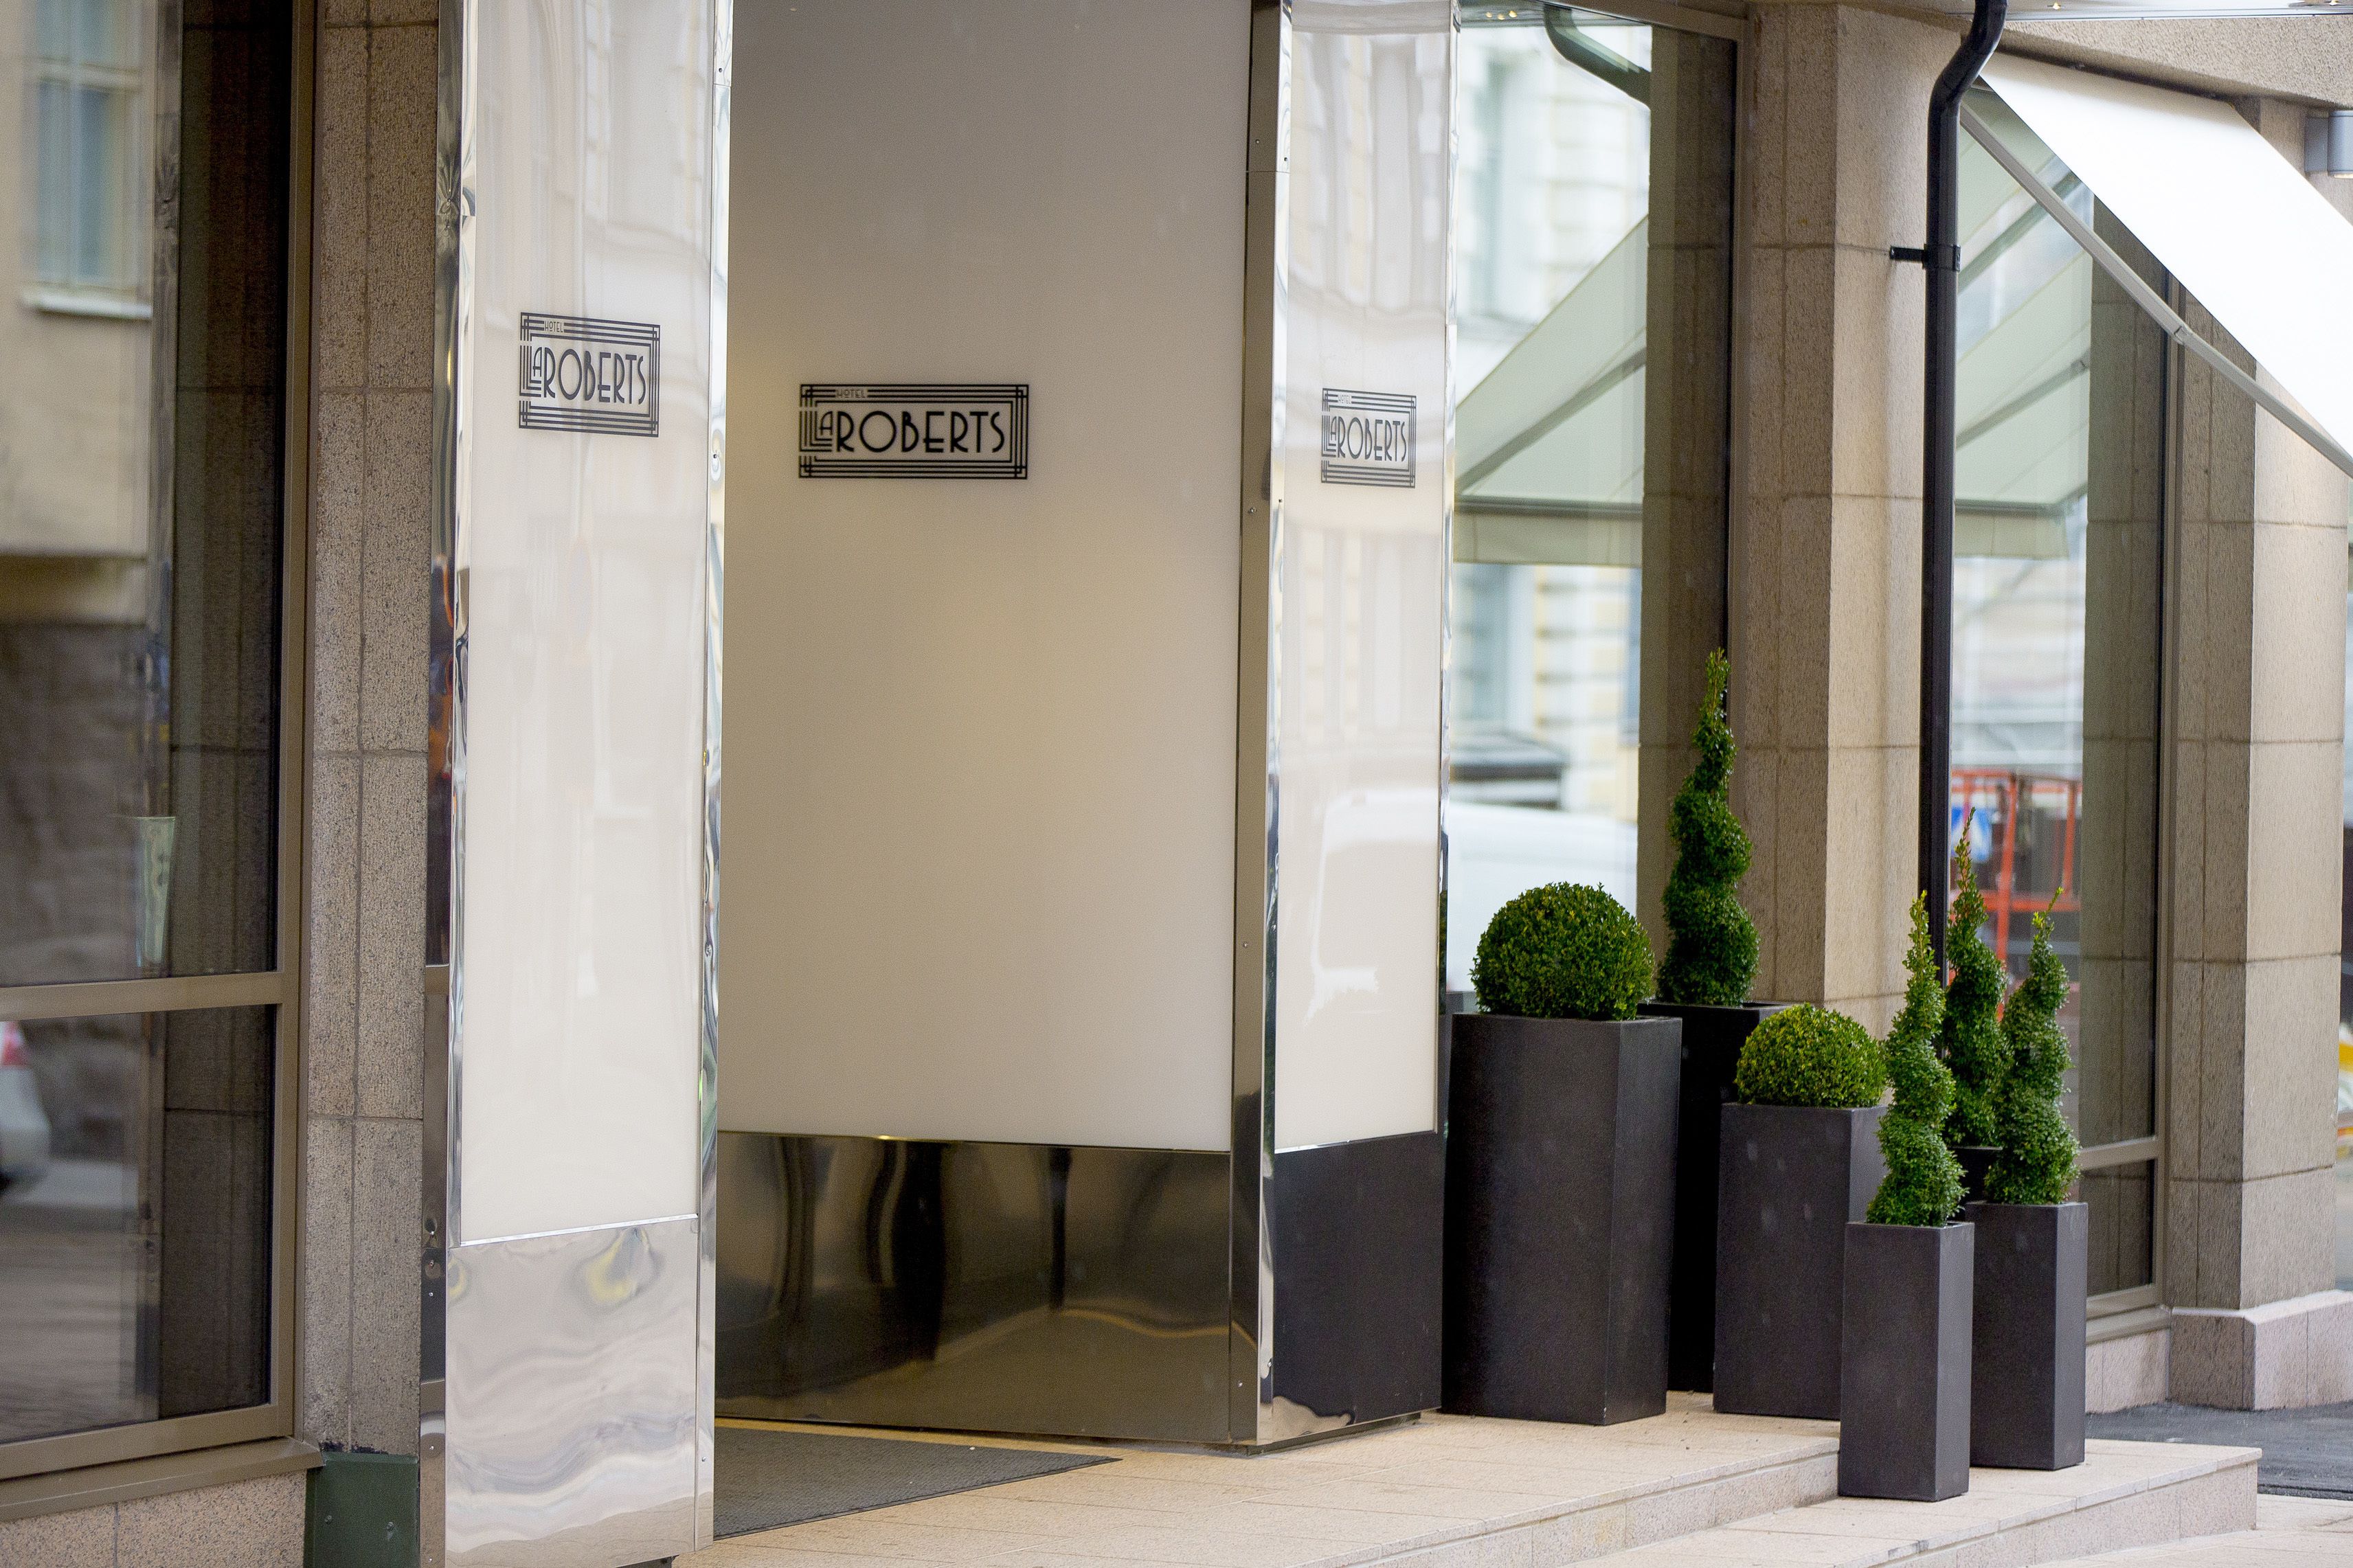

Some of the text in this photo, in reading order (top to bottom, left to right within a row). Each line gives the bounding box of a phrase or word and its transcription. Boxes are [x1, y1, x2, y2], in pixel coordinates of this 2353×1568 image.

[544, 320, 564, 333] HOTEL
[543, 347, 646, 405] ROBERTS
[837, 411, 1005, 453] ROBERTS
[1337, 416, 1407, 462] ROBERTS
